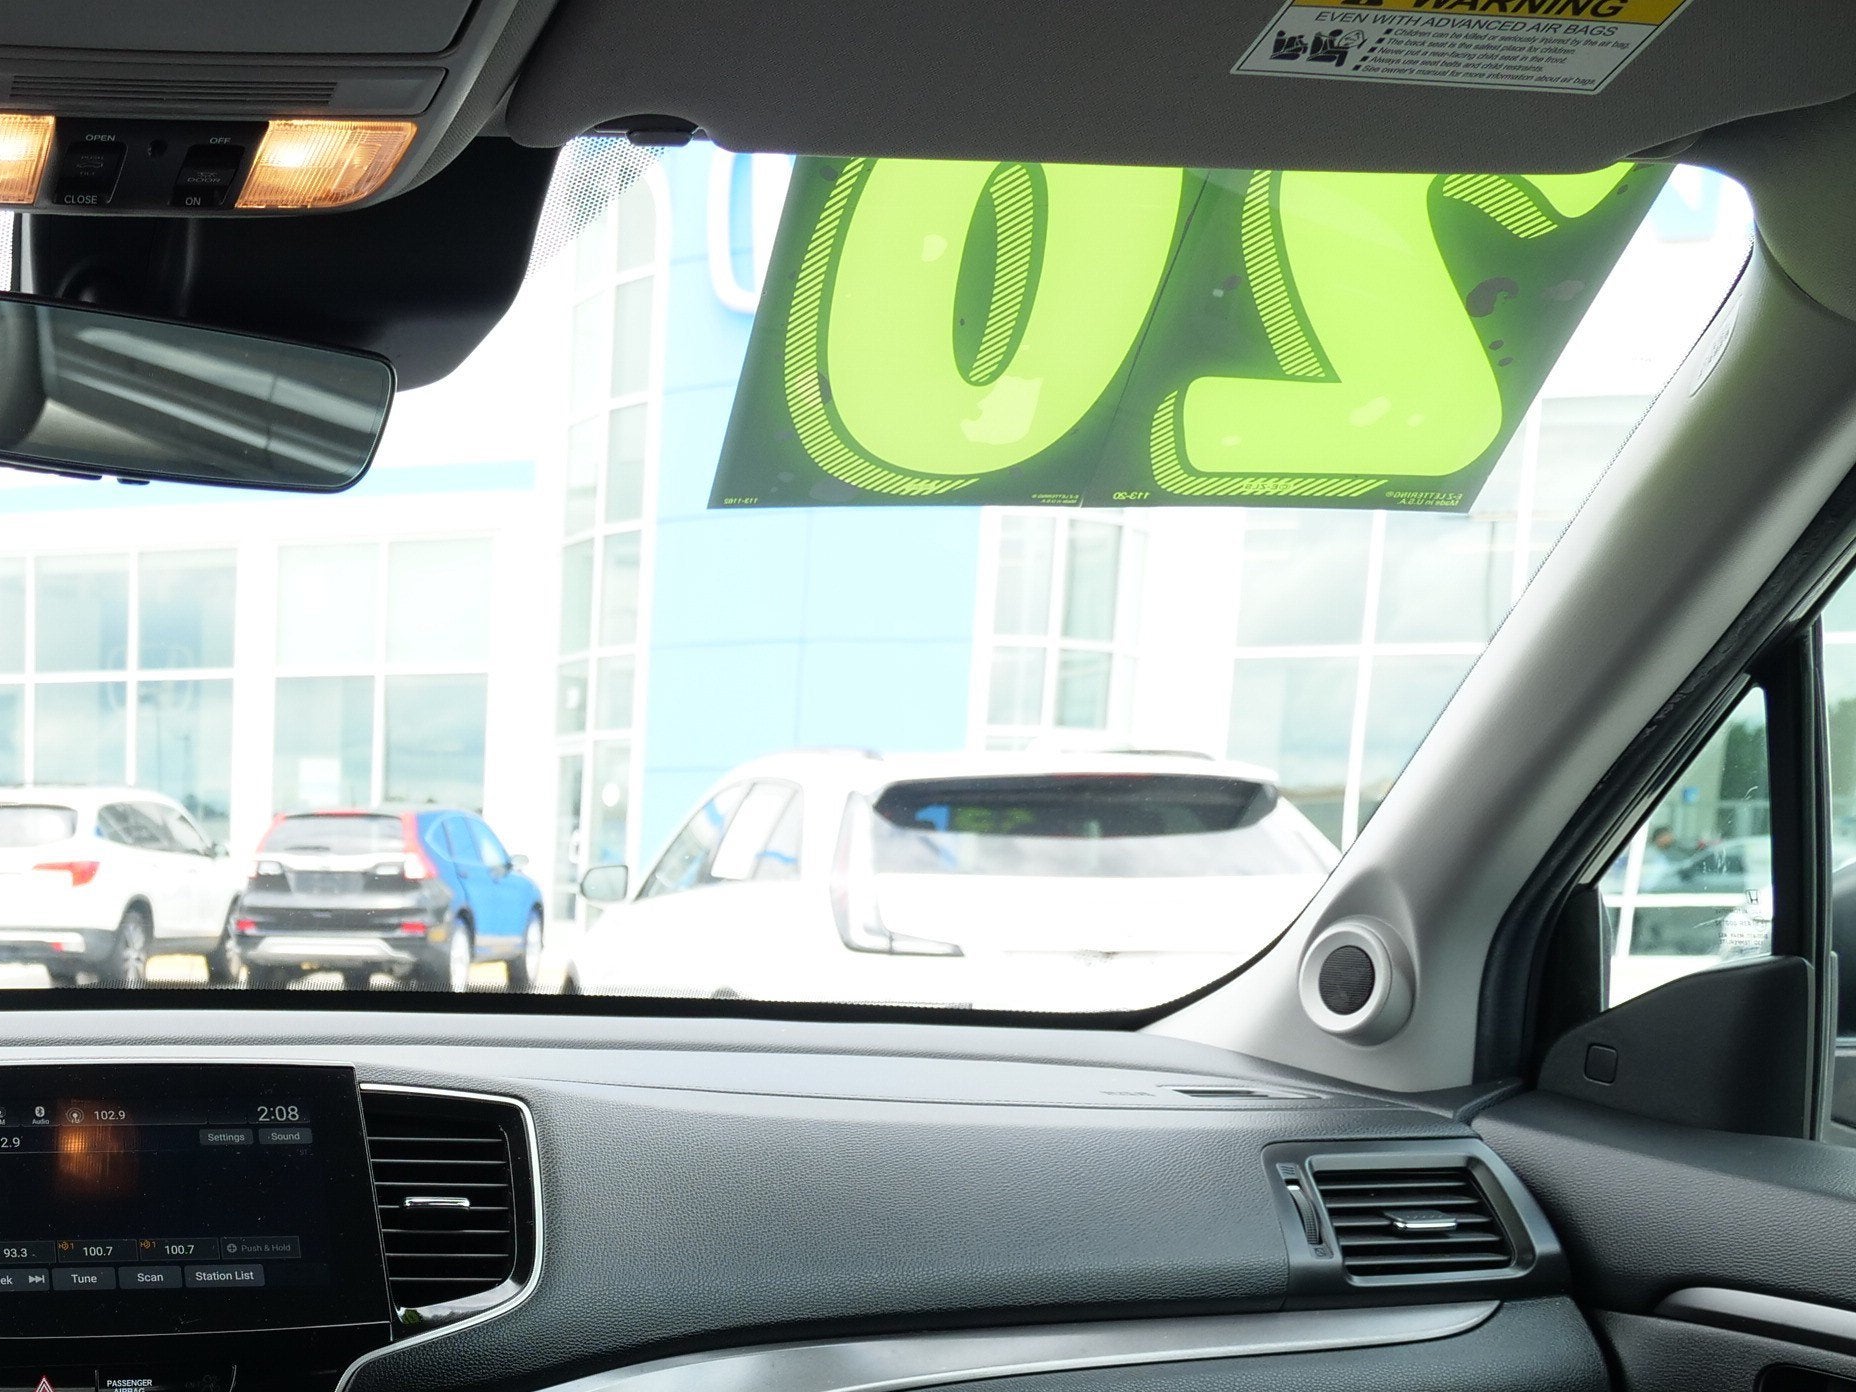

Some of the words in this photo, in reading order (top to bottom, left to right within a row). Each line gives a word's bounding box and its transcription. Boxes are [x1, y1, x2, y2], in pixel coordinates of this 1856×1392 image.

[1315, 11, 1369, 23] EVEN
[1371, 14, 1424, 26] WITH
[1424, 17, 1527, 32] ADVANCED
[1527, 22, 1563, 34] AIR
[1562, 24, 1619, 37] BAGS
[1394, 29, 1431, 37] Children
[1499, 34, 1539, 44] seriously
[1540, 36, 1569, 44] injured
[1370, 56, 1402, 65] Always
[1486, 73, 1534, 81] information
[85, 134, 116, 142] OPEN
[64, 195, 98, 204] CLOSE
[185, 196, 202, 206] ON
[94, 1110, 126, 1120] 102.9
[257, 1105, 300, 1122] 2:08
[208, 1133, 245, 1143] Settings
[271, 1132, 300, 1141] Sound
[3, 1248, 28, 1258] 93.3
[82, 1246, 113, 1257] 100.7
[164, 1245, 194, 1255] 100.7
[271, 1244, 291, 1252] Hold
[71, 1274, 97, 1284] Tune
[137, 1273, 164, 1283] Scan
[195, 1271, 232, 1281] Station
[234, 1271, 255, 1280] List
[106, 1379, 152, 1388] PASSENGER
